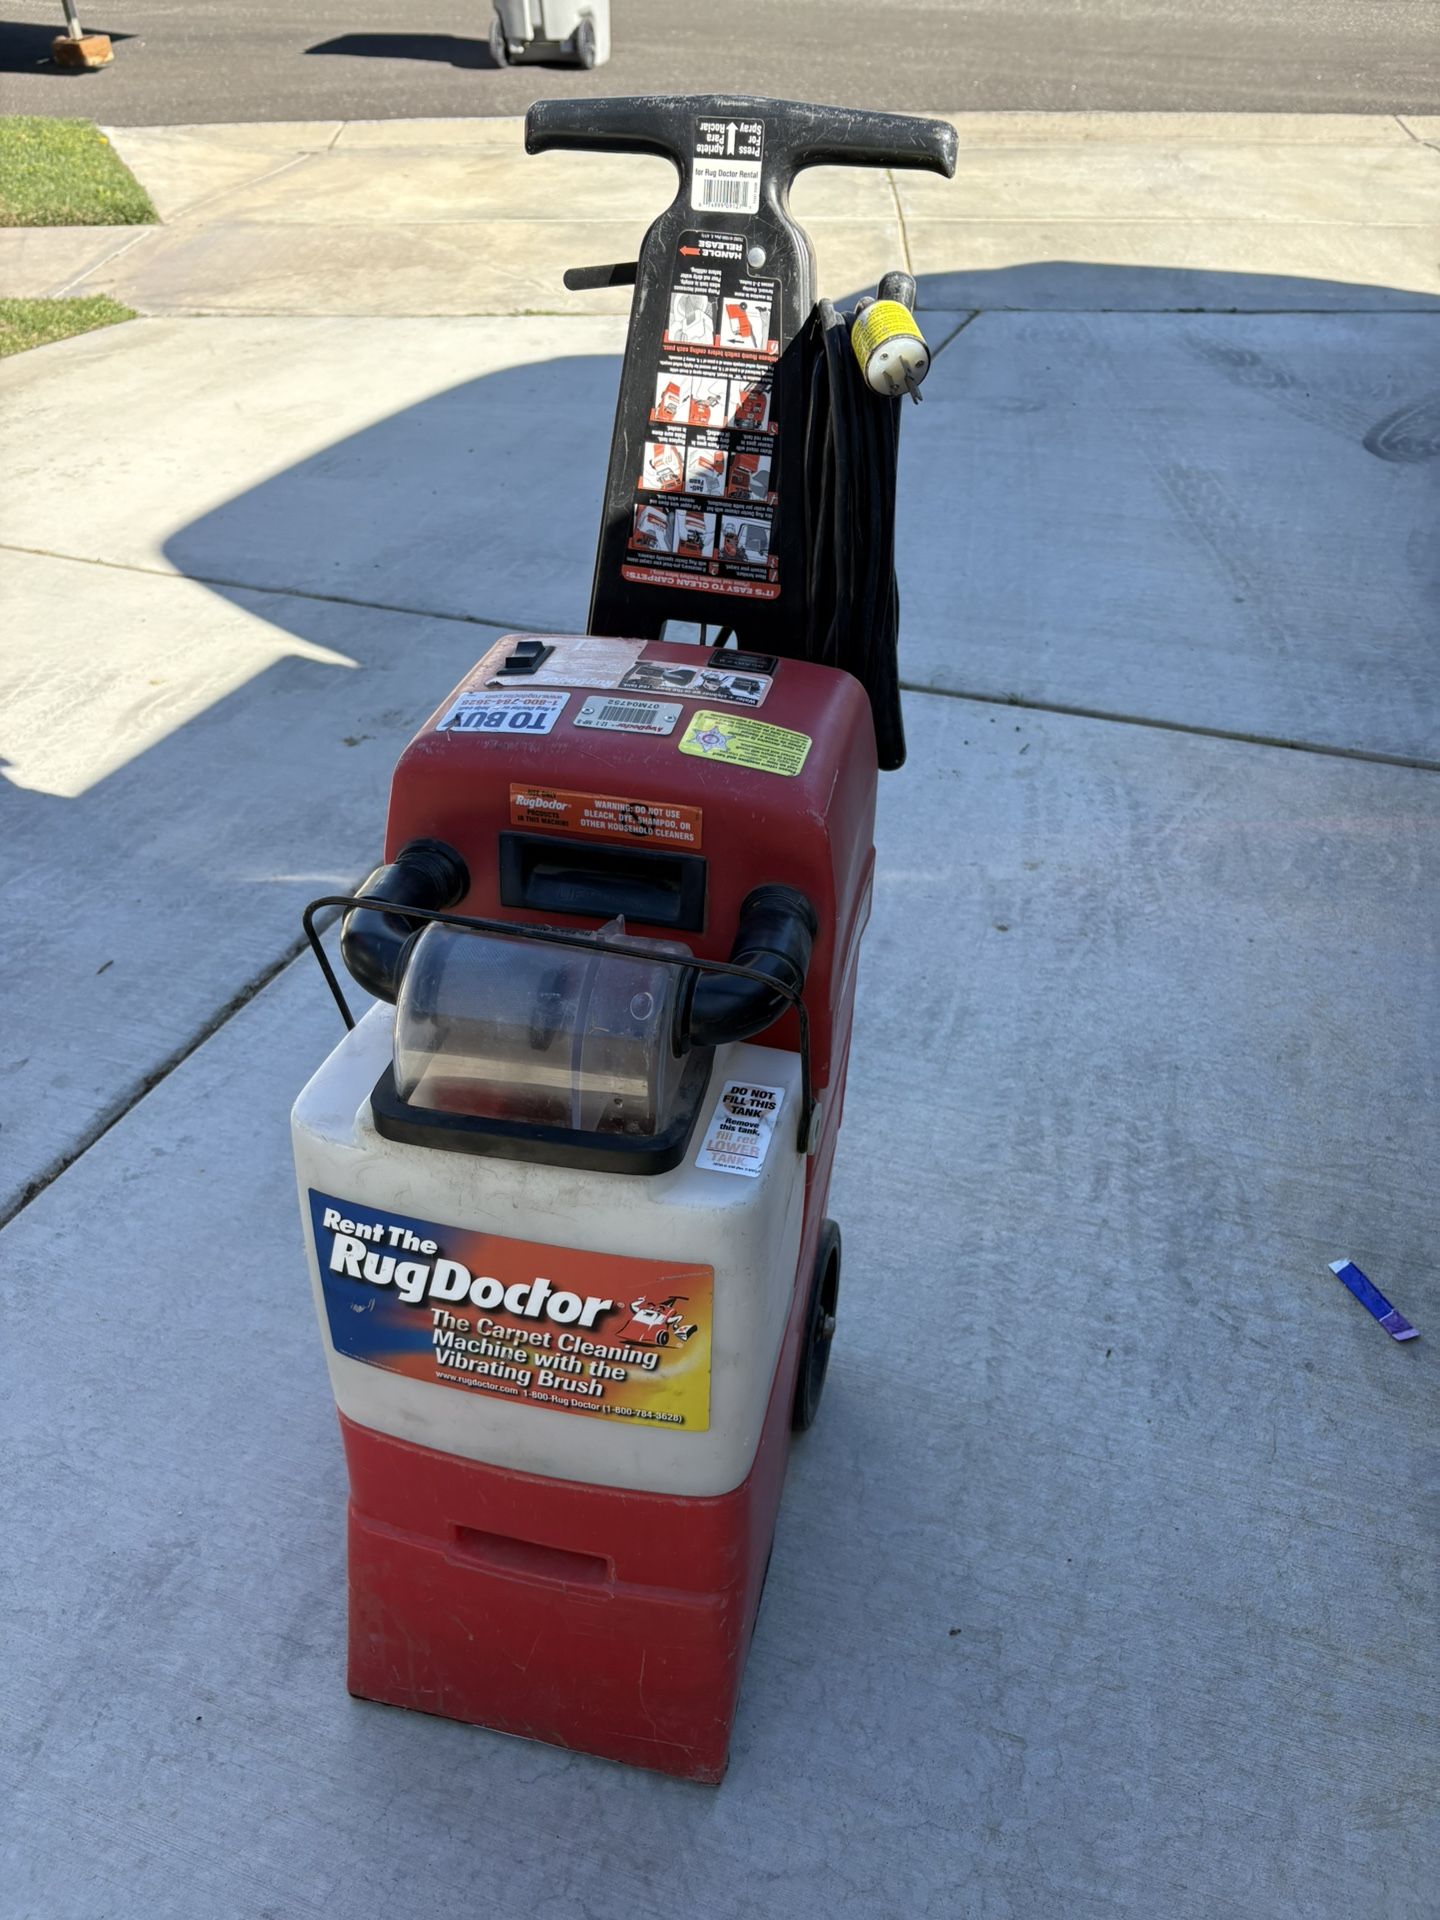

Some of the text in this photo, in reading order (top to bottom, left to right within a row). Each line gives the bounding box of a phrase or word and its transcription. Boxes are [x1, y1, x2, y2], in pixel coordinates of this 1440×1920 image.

[700, 122, 725, 133] Rociar
[740, 123, 762, 134] Spray
[706, 134, 724, 144] Para
[748, 136, 761, 145] For
[697, 144, 724, 155] Apriete
[739, 146, 760, 157] Press
[705, 169, 716, 177] Rug
[698, 240, 743, 252] RELEASE
[702, 249, 742, 260] HANDLE
[626, 571, 674, 584] CARPETS:
[677, 579, 709, 589] CLEAN
[727, 585, 752, 594] EASY
[755, 589, 774, 597] IT'S
[607, 699, 659, 709] 07M04752
[736, 697, 756, 705] Water
[442, 712, 547, 730] TO BUY
[515, 795, 568, 810] RugDoctor
[594, 800, 680, 818] WARNING: DO NOT USE
[584, 809, 617, 821] BLEACH,
[637, 817, 678, 830] SHAMPOO,
[680, 821, 691, 830] OR
[580, 819, 694, 841] OTHER HOUSEHOLD CLEANERS
[731, 1087, 776, 1100] DO NOT
[723, 1095, 776, 1110] FILL THIS
[731, 1106, 762, 1118] TANK
[720, 1124, 735, 1132] this
[725, 1118, 759, 1128] Remove
[737, 1136, 757, 1144] red
[707, 1140, 760, 1156] LOWER
[711, 1152, 748, 1166] TANK
[322, 1208, 438, 1254] Rent The
[329, 1232, 613, 1328] RugDoctor
[431, 1308, 659, 1370] The Carpet Cleaning
[432, 1328, 627, 1380] Machine with the
[435, 1348, 532, 1387] Vibrating
[538, 1370, 604, 1397] Brush
[435, 1370, 684, 1424] www.rugdoctor.com 1-800-Rug Doctor (1-800-784-3628)
